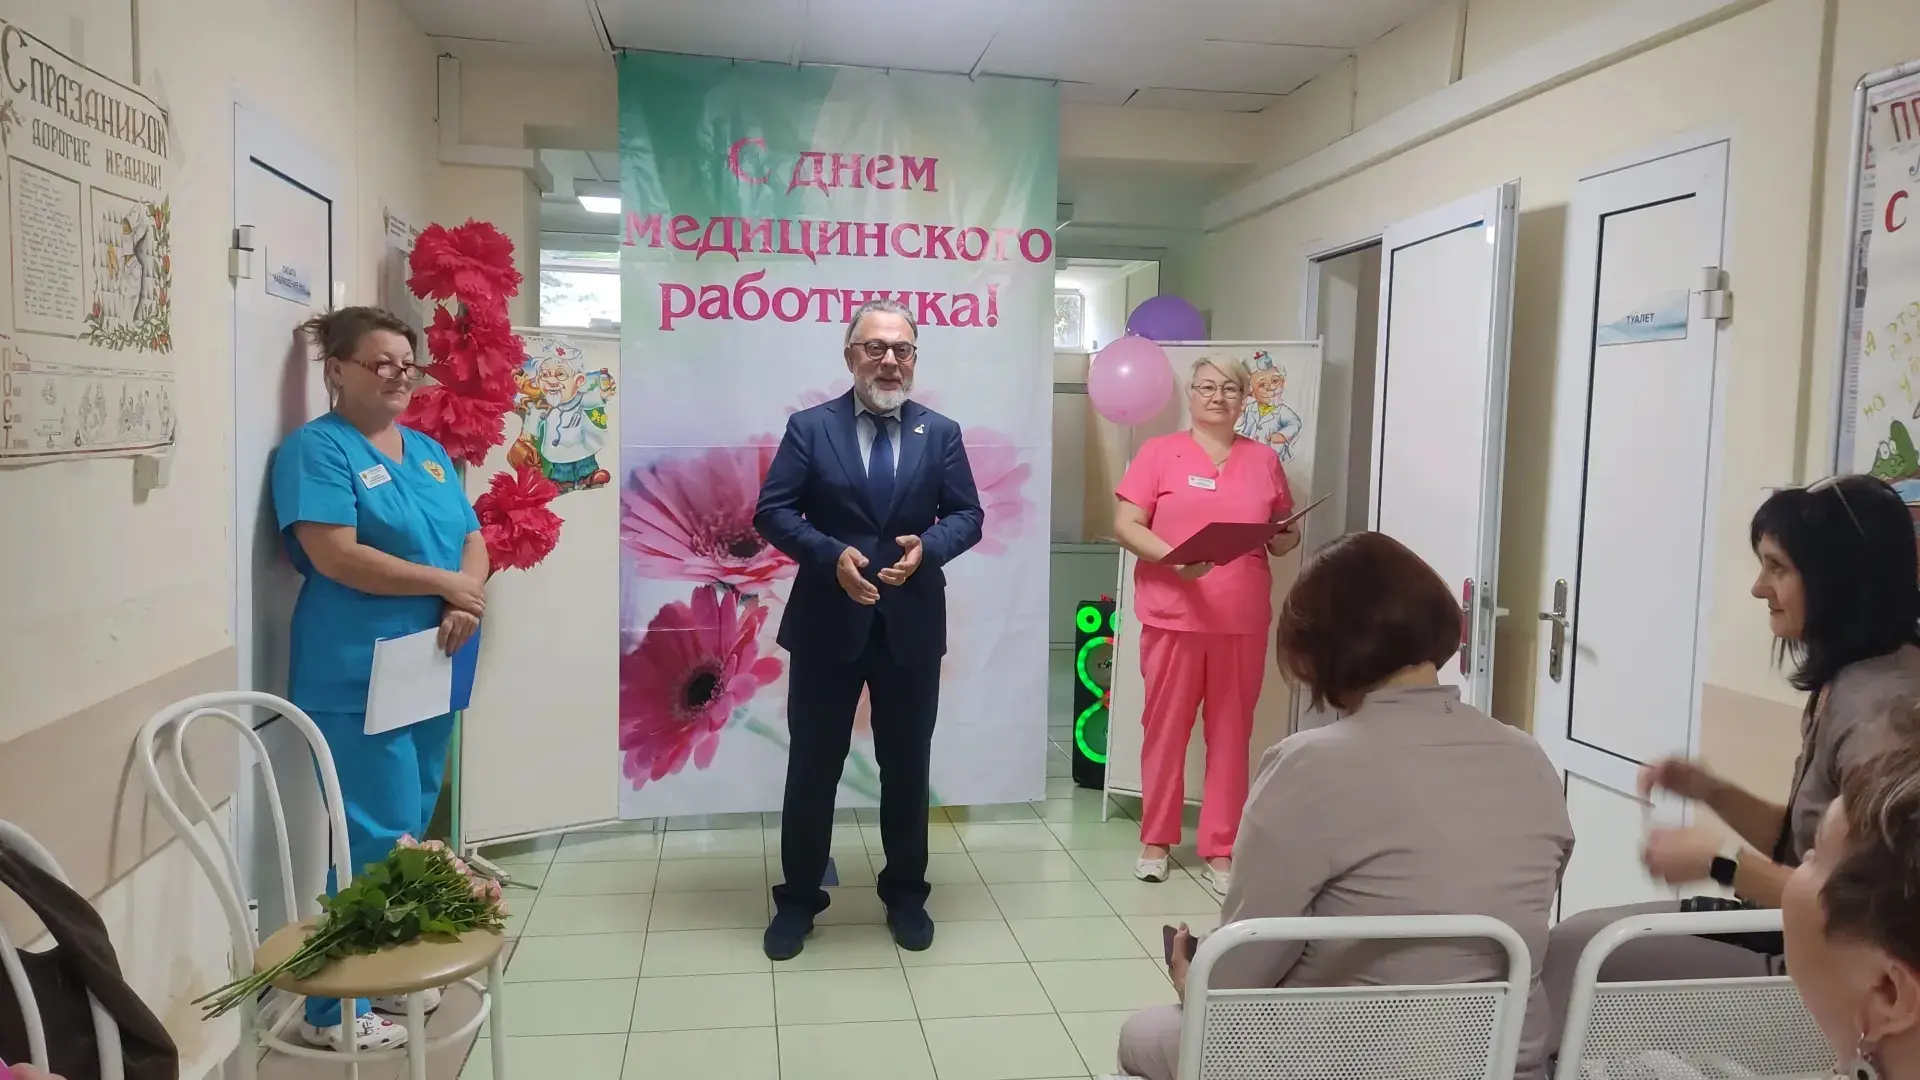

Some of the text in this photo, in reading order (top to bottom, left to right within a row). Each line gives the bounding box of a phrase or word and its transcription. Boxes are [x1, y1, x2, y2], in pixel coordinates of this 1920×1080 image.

[1, 24, 168, 159] С ПРАЗДНИКОМ
[32, 118, 91, 167] ДОРОГИЕ
[728, 137, 939, 197] С днем
[622, 213, 1053, 265] медицинского
[1626, 312, 1655, 324] ТУАЛЕТ
